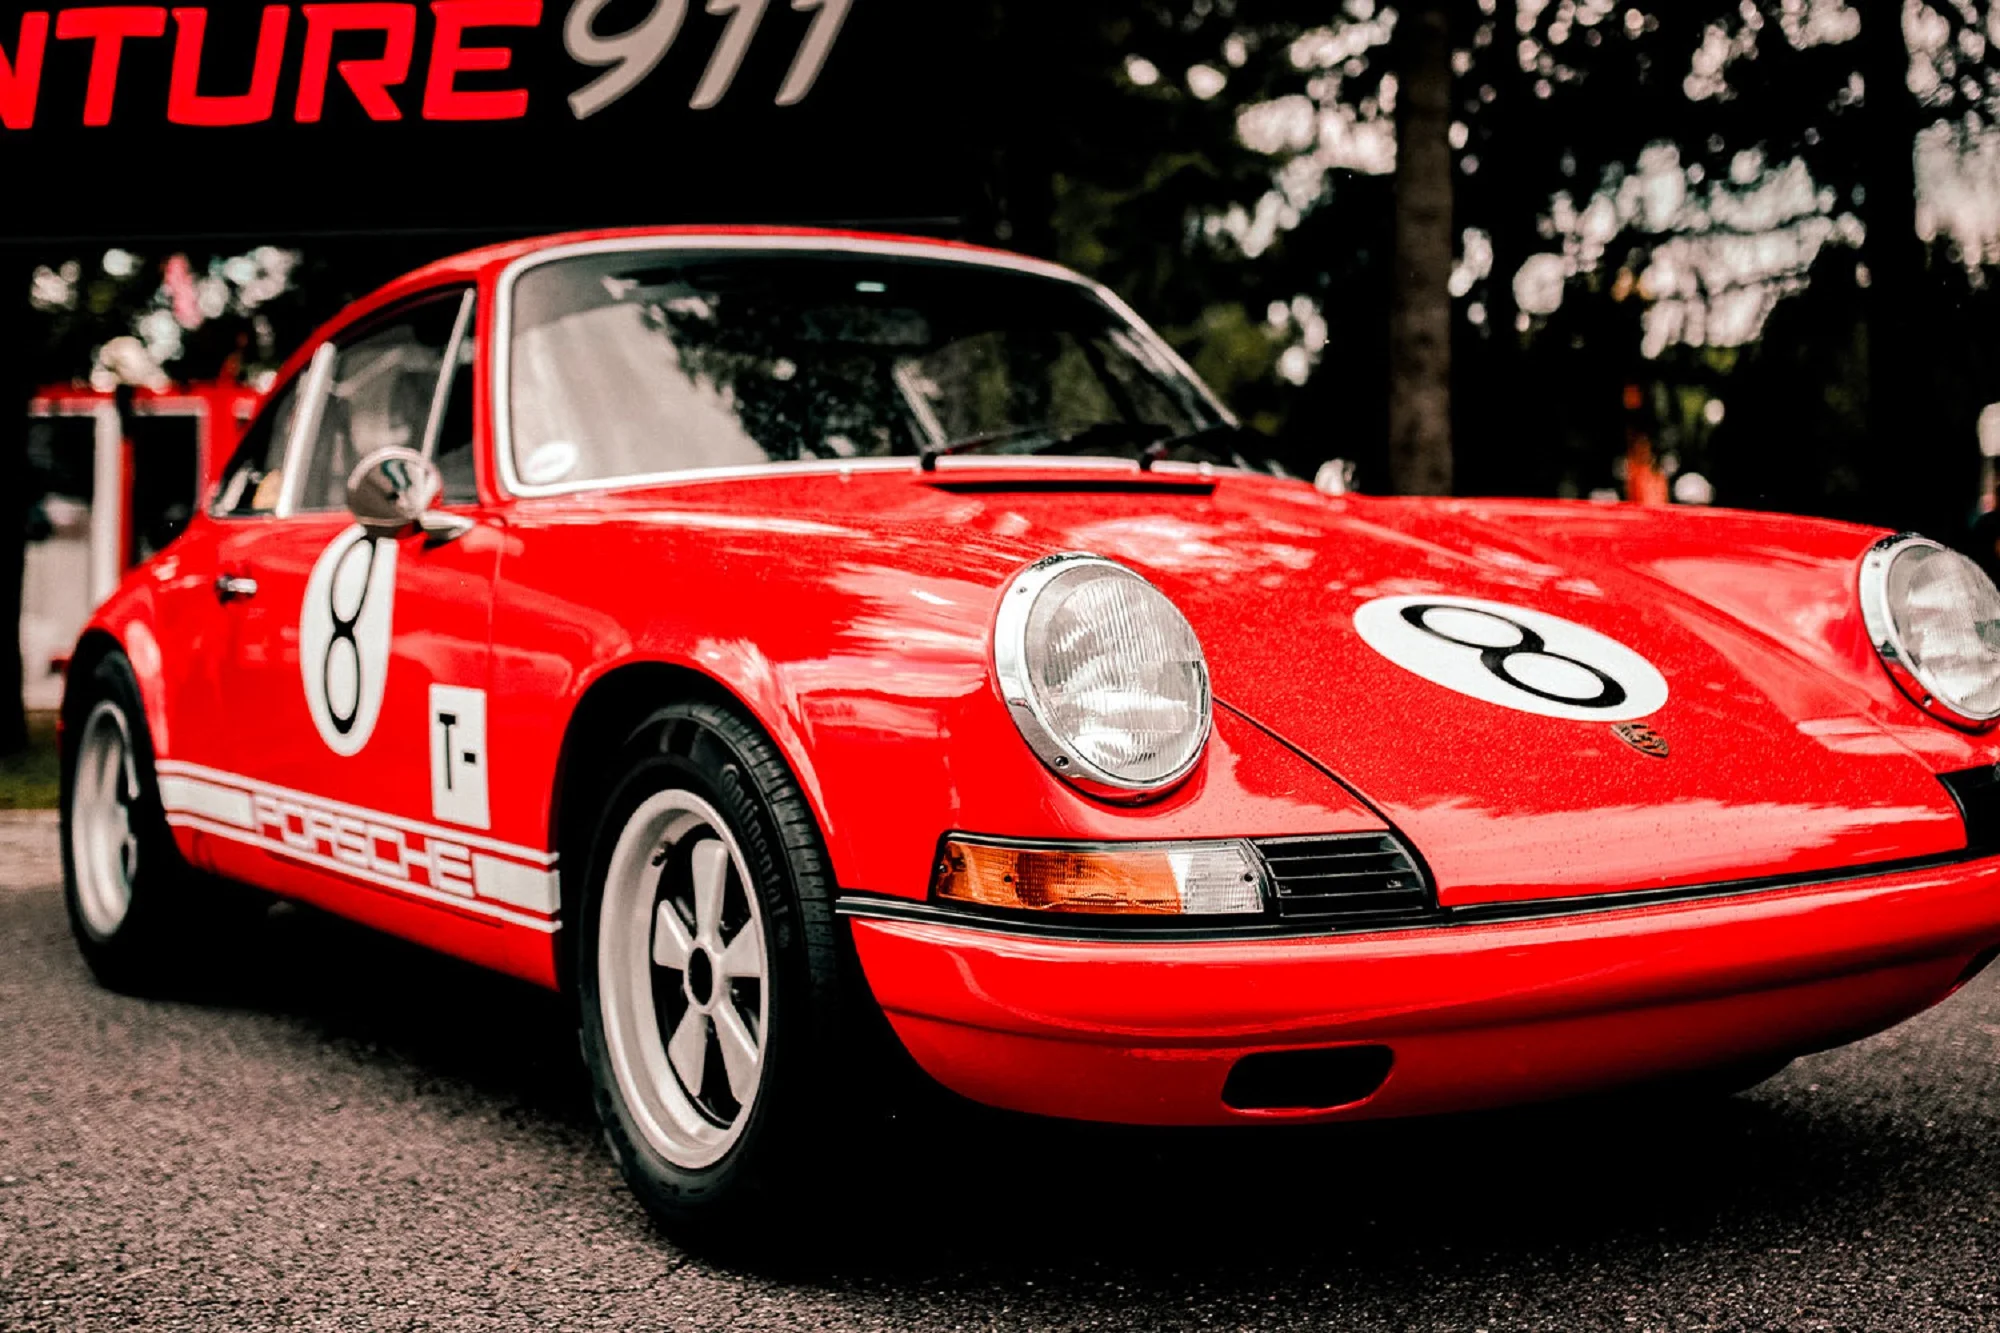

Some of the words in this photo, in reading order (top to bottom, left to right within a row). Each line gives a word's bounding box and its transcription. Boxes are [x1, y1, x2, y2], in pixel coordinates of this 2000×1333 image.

[563, 0, 852, 120] 911
[324, 535, 377, 734] 8
[1400, 604, 1627, 708] 8
[252, 792, 476, 899] PORSCHE
